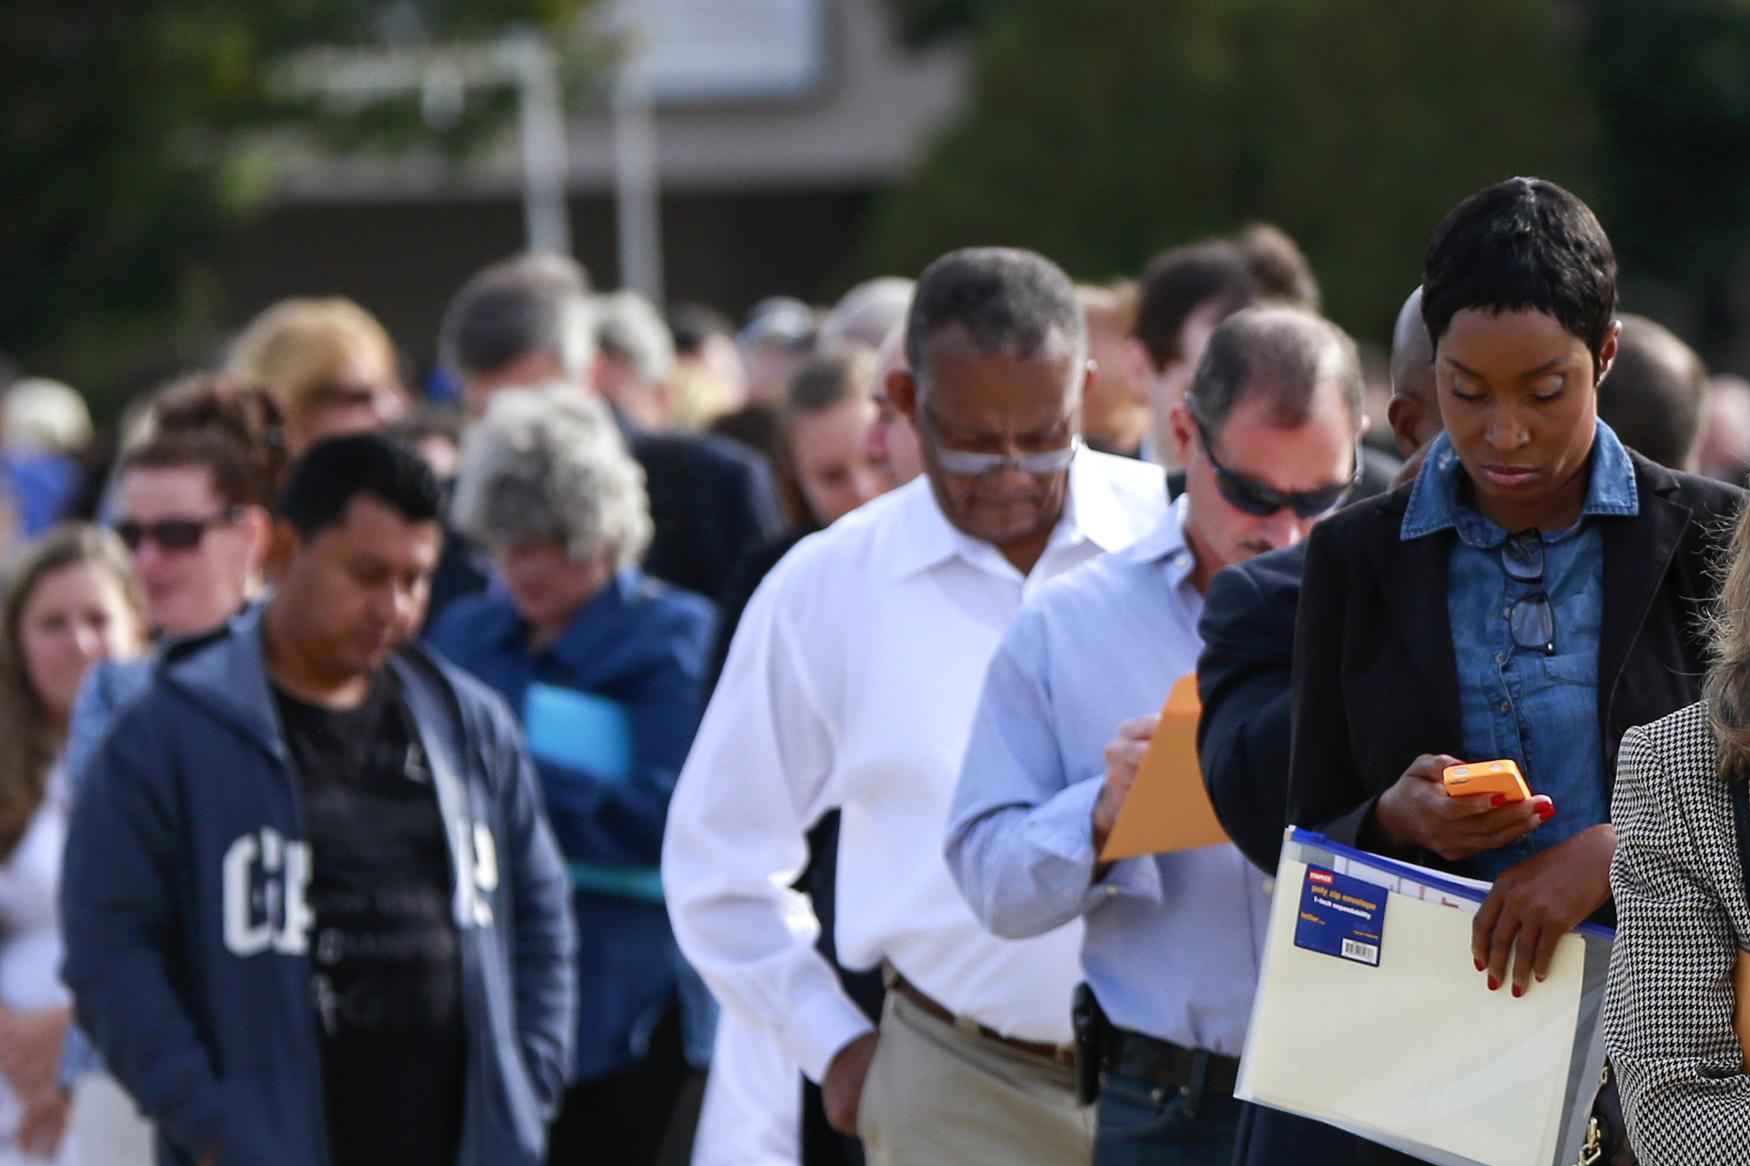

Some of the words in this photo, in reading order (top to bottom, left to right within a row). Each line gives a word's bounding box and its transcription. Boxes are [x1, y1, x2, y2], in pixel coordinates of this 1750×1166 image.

[1311, 885, 1329, 897] poly
[1329, 891, 1342, 901] zip
[1342, 895, 1377, 911] envelope
[1332, 903, 1372, 920] expandability
